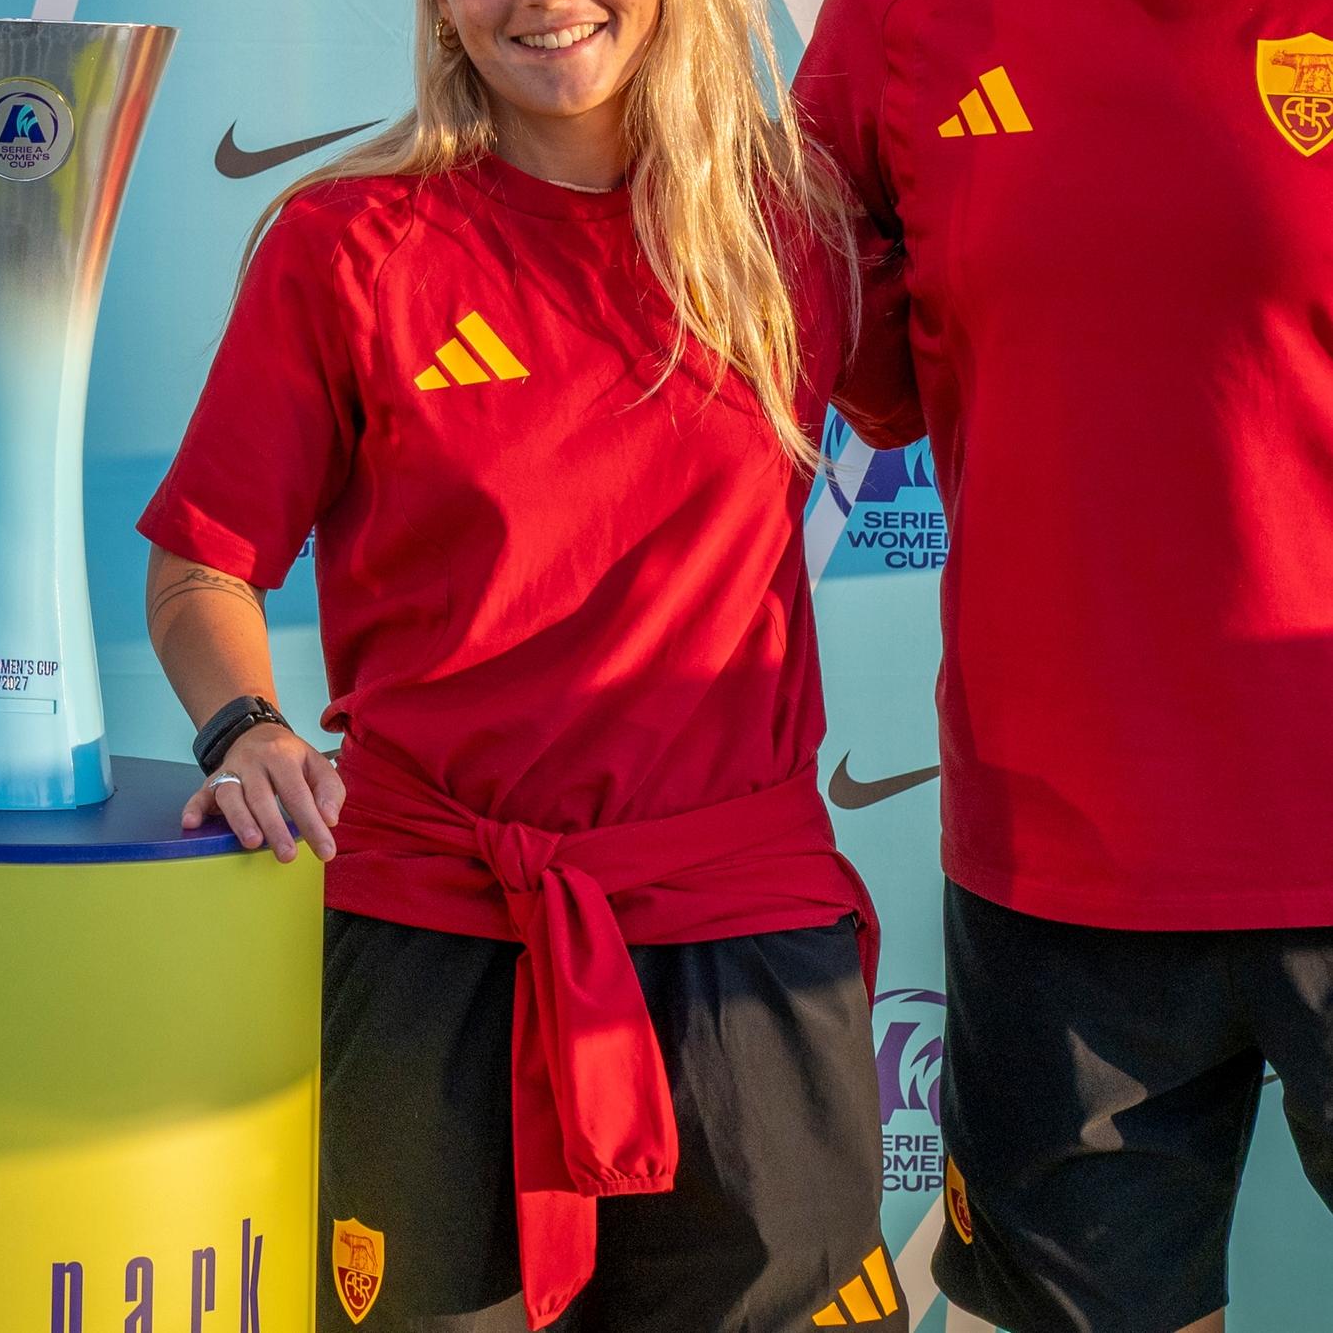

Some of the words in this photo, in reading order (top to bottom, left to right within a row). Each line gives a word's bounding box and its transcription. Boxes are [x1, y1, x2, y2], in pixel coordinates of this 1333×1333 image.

[863, 511, 944, 529] SERIE
[847, 530, 948, 549] WOME
[884, 551, 947, 569] CUP
[37, 660, 59, 676] CUP
[883, 1174, 943, 1192] CUP
